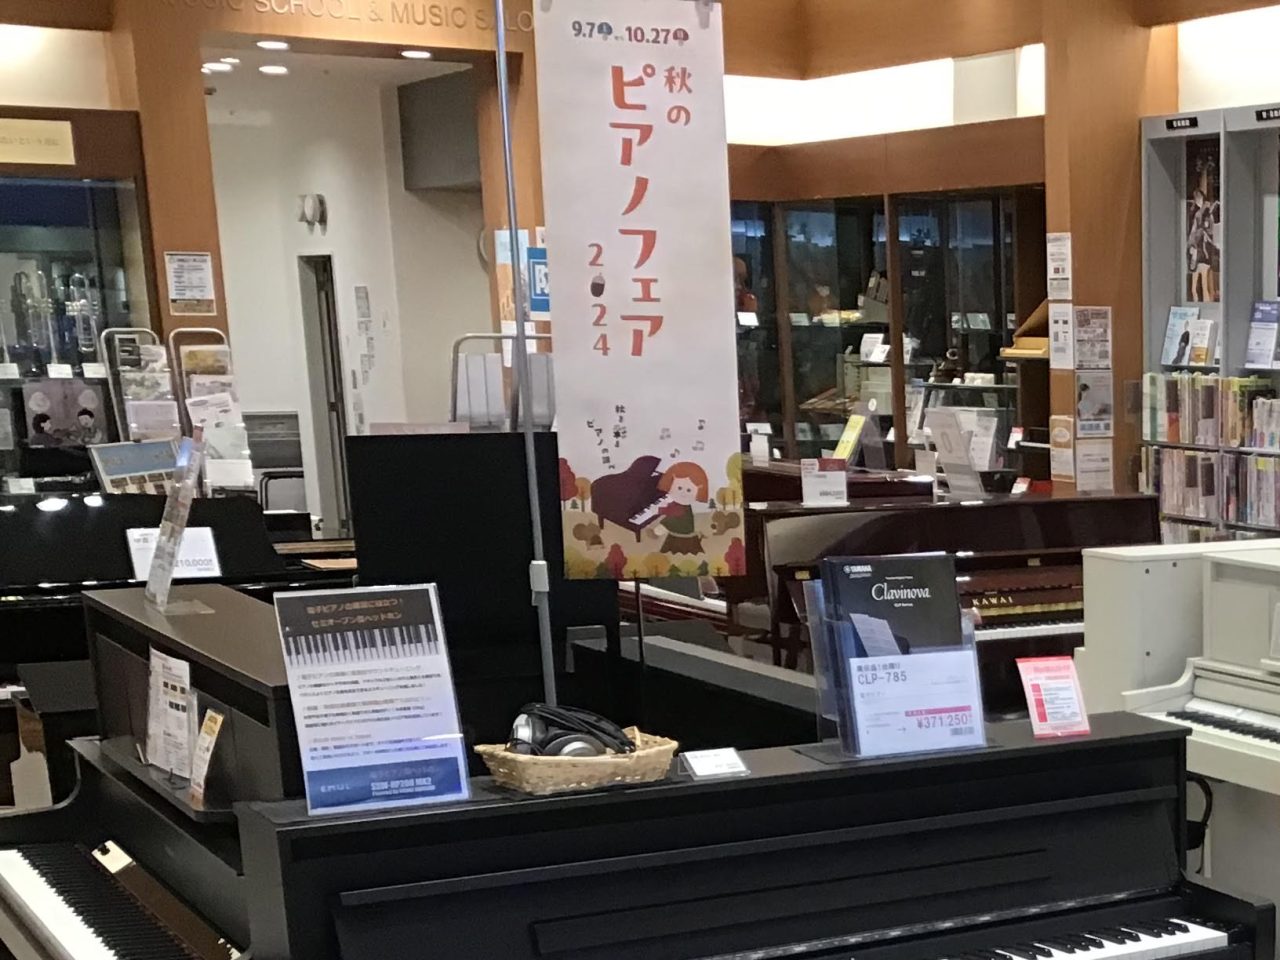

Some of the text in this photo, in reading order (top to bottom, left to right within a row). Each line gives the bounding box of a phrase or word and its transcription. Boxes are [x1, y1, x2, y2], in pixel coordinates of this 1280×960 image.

[390, 2, 467, 29] MUSIC
[625, 26, 671, 45] 10.27
[664, 66, 693, 126] 秋の
[608, 63, 664, 357] ピアノフェア
[871, 582, 931, 601] Clavinova
[972, 596, 1013, 606] KAWAI
[857, 671, 908, 686] CLP-785
